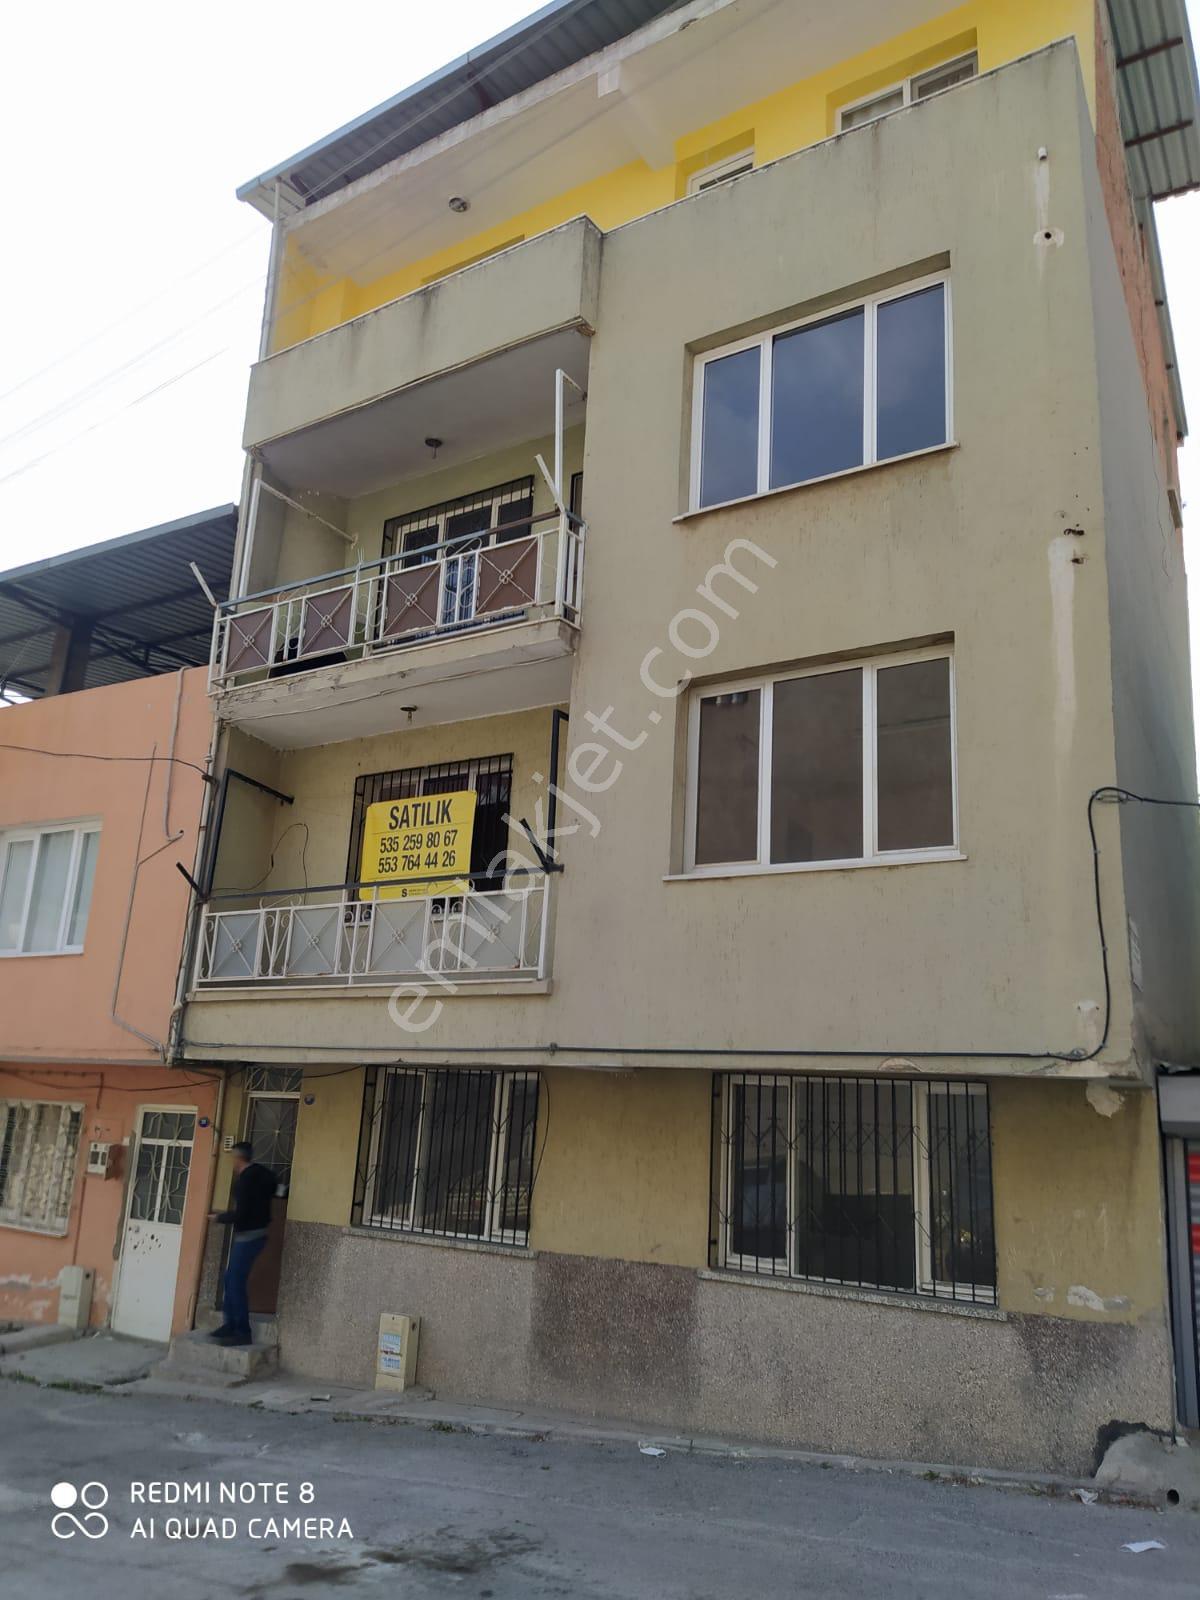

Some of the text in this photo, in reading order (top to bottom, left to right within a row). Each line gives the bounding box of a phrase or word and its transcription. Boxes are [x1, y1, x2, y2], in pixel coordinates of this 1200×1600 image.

[388, 799, 453, 830] SATILIK
[380, 829, 458, 854] 535 259 80 67
[378, 850, 456, 874] 553 764 44 26
